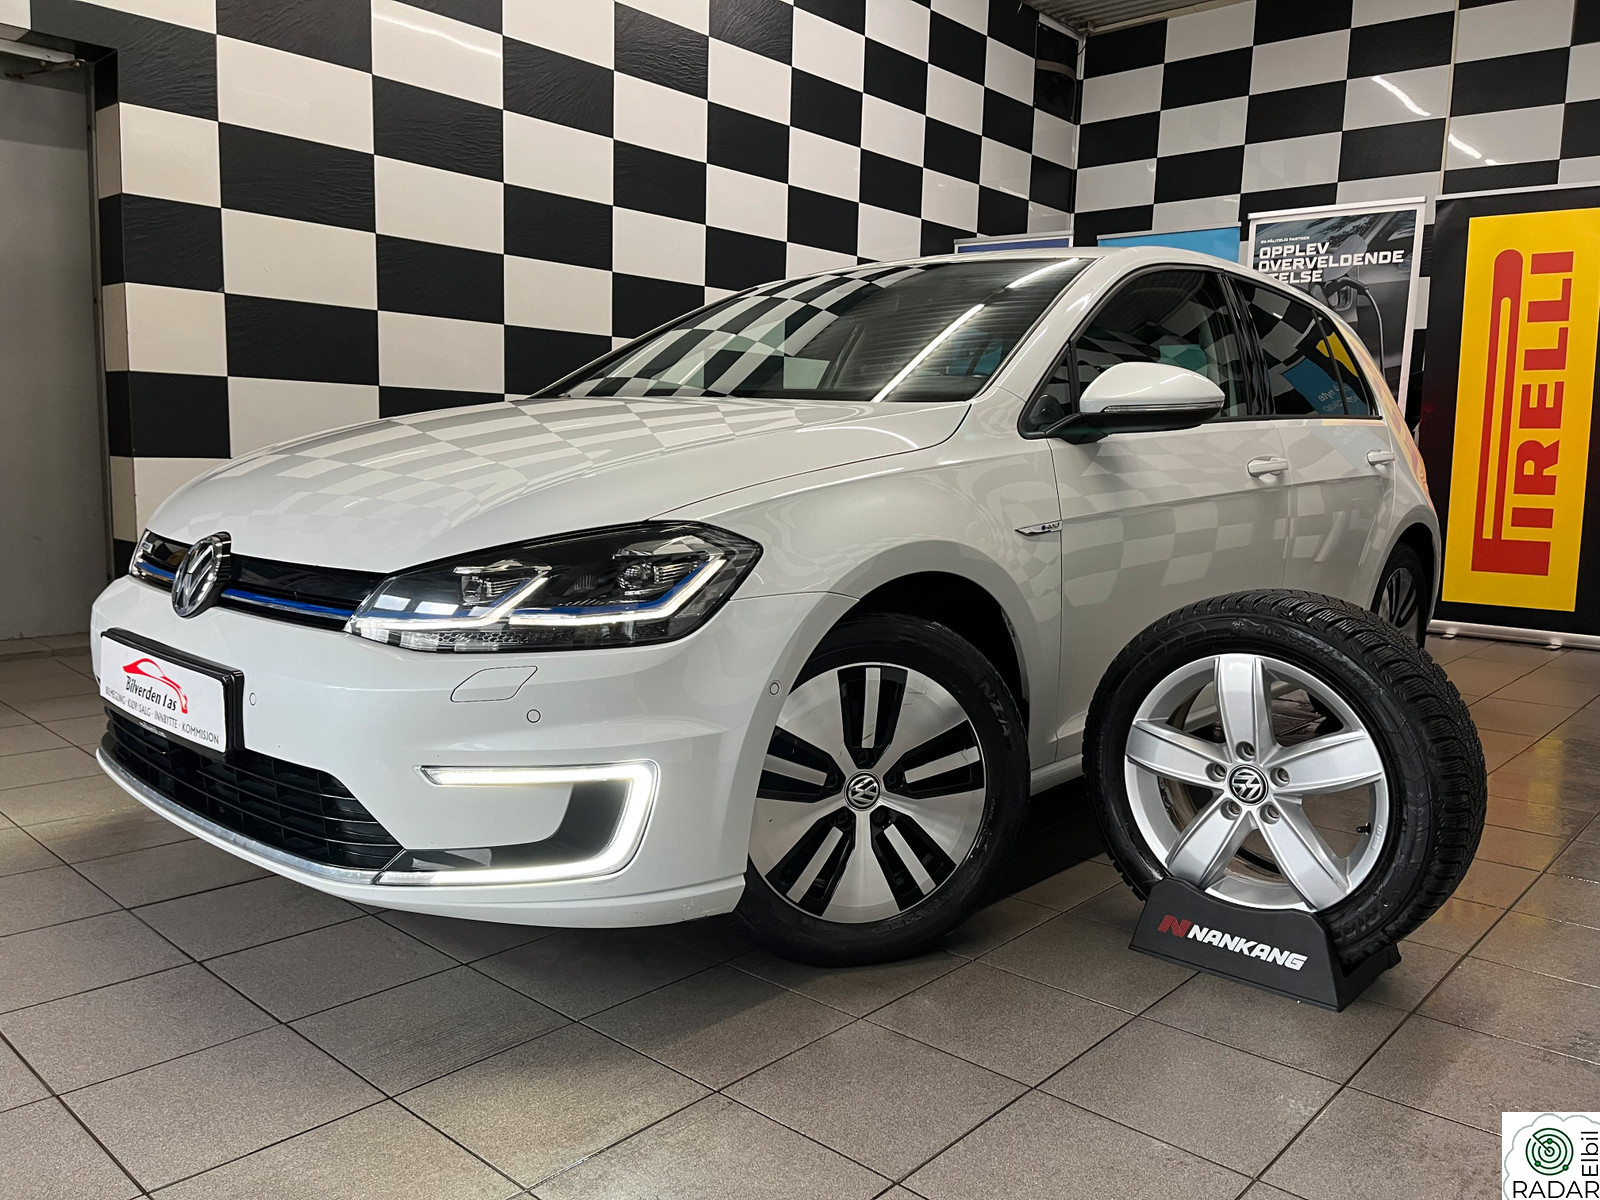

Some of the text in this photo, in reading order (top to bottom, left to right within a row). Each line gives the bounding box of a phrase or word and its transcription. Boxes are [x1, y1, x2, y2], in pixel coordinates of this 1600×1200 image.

[1258, 250, 1405, 272] OVERVELDENDE
[1259, 242, 1330, 259] OPPLEV
[1268, 270, 1323, 283] TELSE
[1471, 249, 1574, 576] PIRELLI
[126, 676, 161, 705] Bilverden
[167, 698, 177, 711] as
[181, 721, 219, 745] KOMMISJON
[1187, 924, 1308, 971] NANKANG
